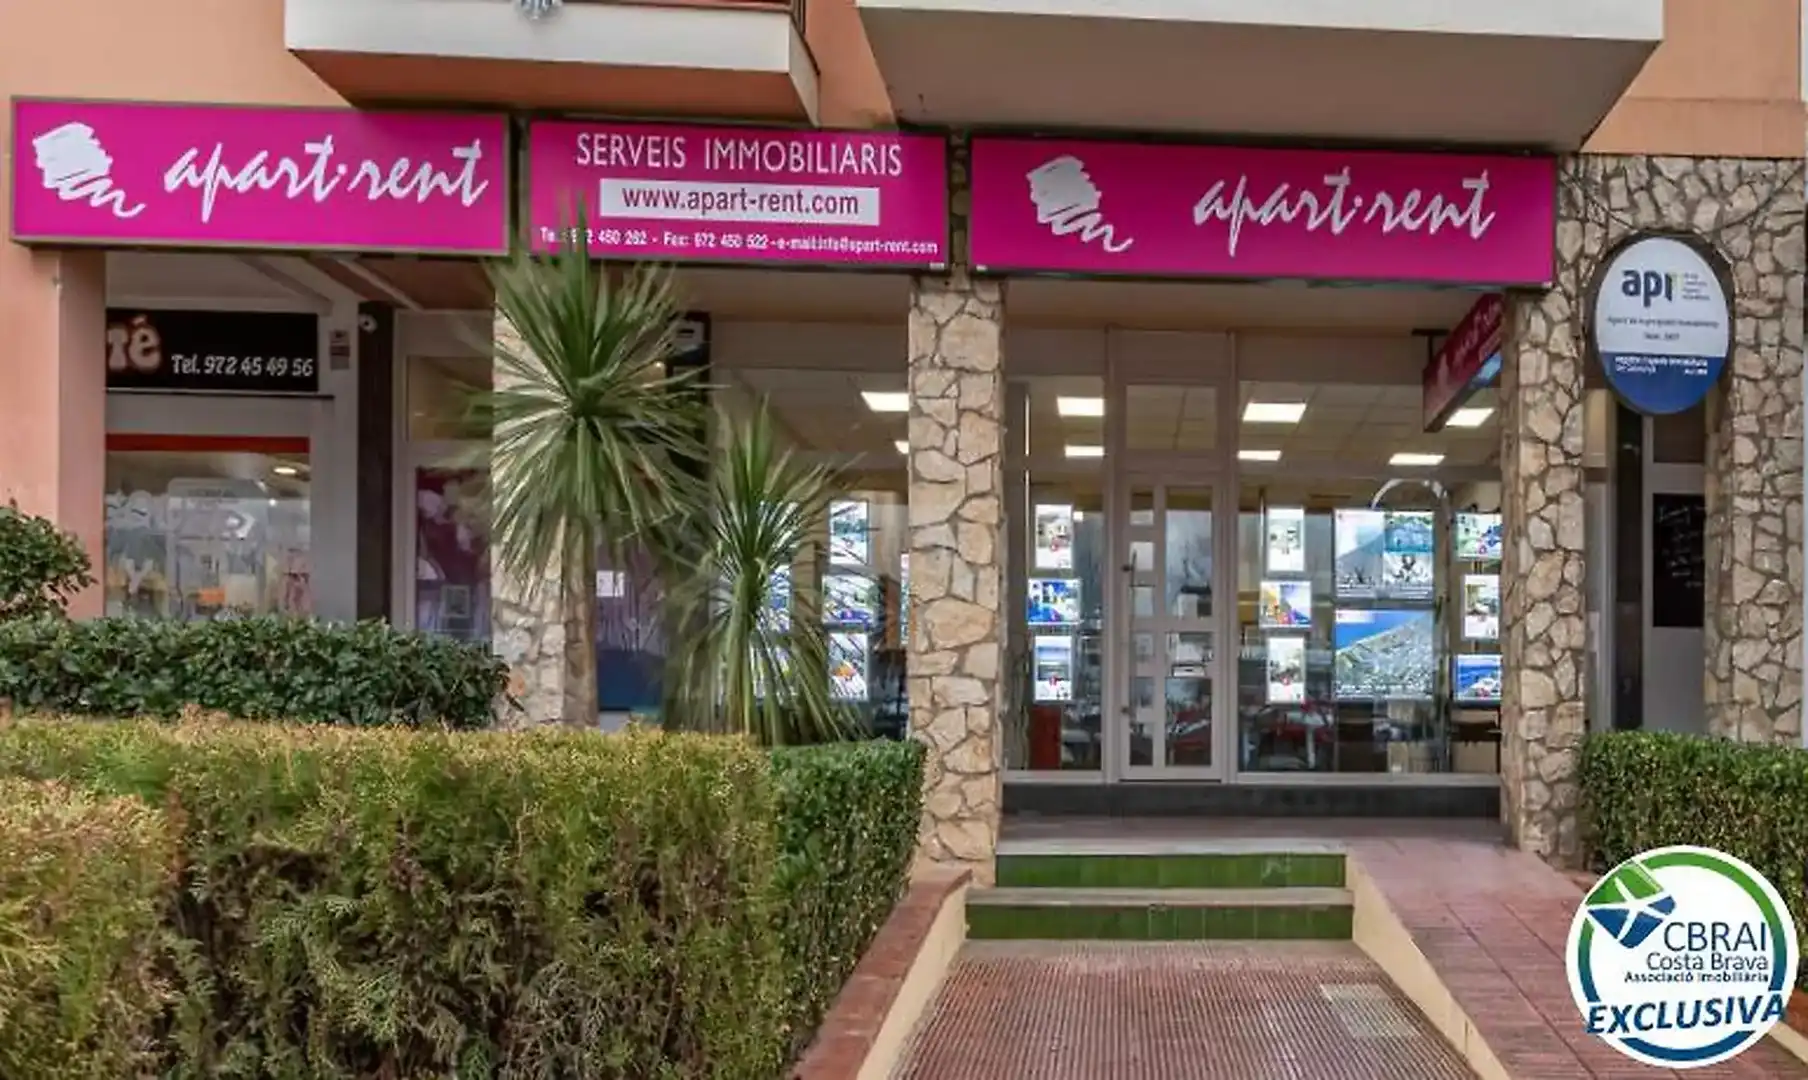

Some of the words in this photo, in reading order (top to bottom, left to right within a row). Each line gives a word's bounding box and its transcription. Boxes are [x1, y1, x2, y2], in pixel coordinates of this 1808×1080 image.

[576, 133, 686, 168] SERVEIS
[705, 139, 902, 176] IMMOBILIARIS
[622, 187, 860, 216] www.apart-rent.com
[171, 354, 200, 374] Tel.
[204, 355, 237, 375] 972
[241, 357, 262, 376] 45
[266, 357, 288, 376] 49
[292, 358, 313, 376] 56
